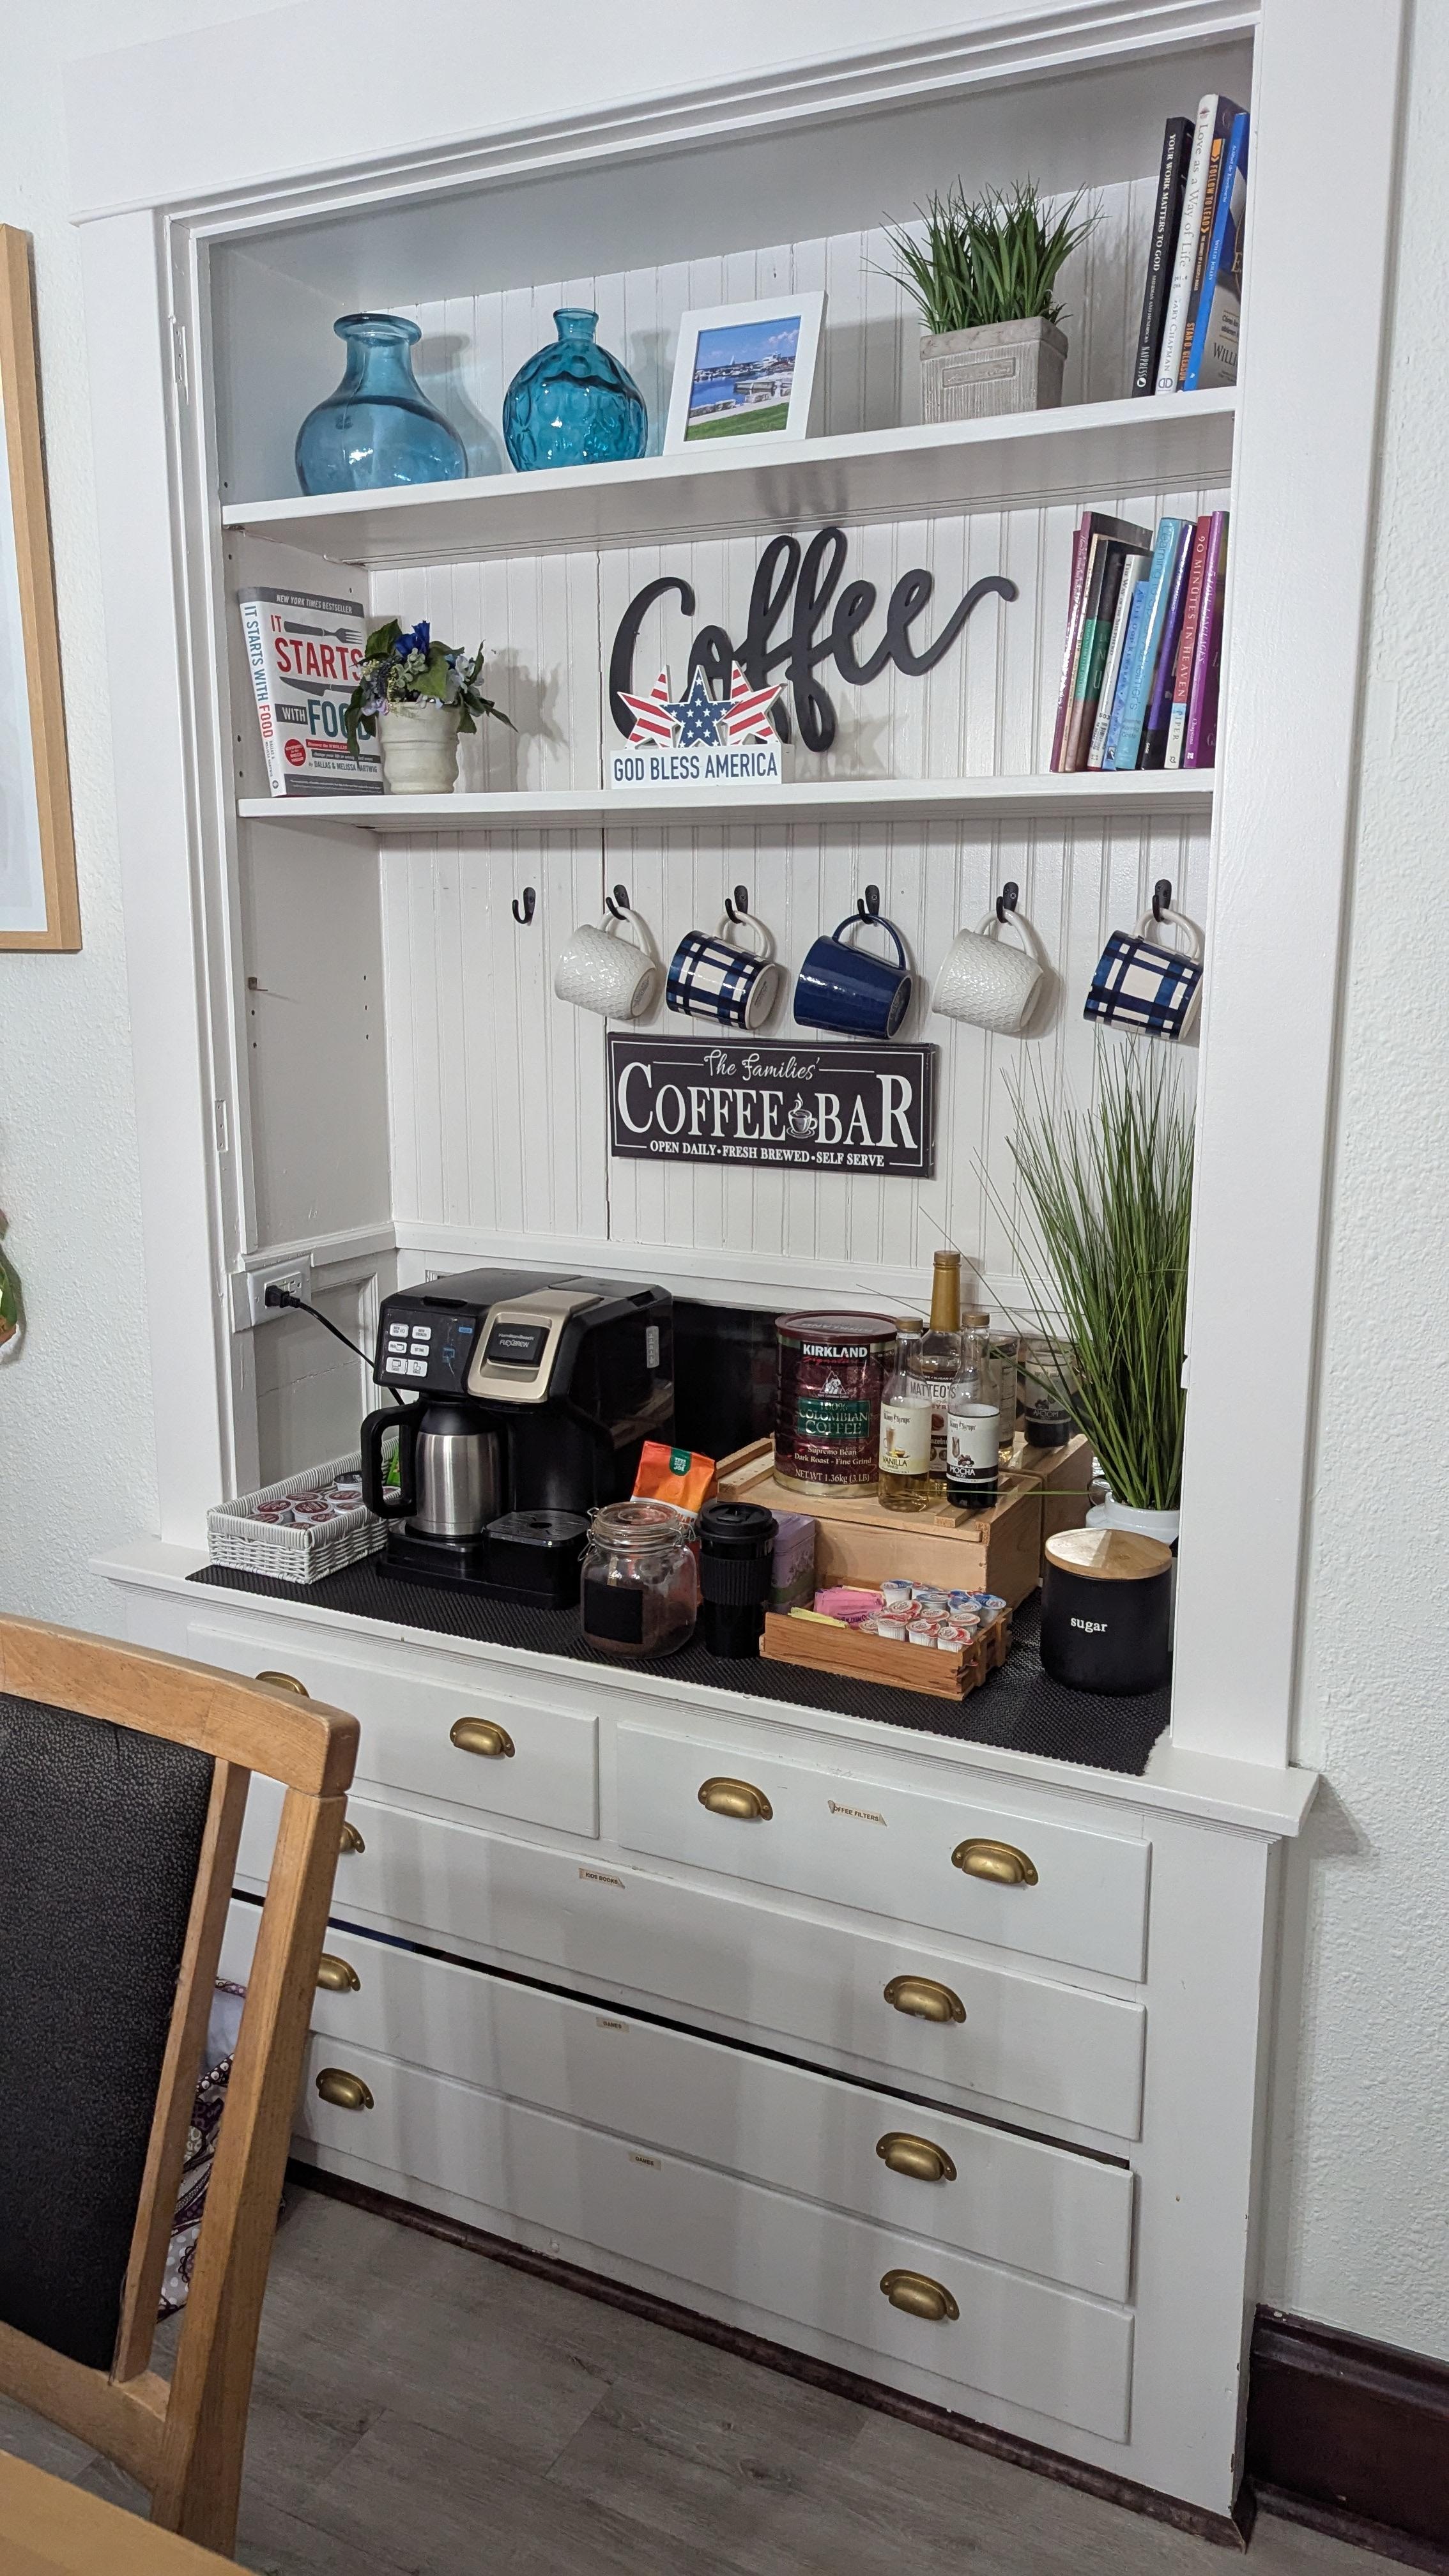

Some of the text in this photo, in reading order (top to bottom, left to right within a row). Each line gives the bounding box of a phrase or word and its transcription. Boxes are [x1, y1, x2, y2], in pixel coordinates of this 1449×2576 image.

[1167, 133, 1175, 160] YOUR
[1195, 123, 1208, 155] Love
[1163, 162, 1171, 190] WORK
[1193, 160, 1200, 172] as
[1184, 188, 1199, 217] Way
[1201, 164, 1218, 226] FOLLOW TO LEAD
[1158, 192, 1168, 233] MATTERS
[1156, 234, 1163, 247] TO
[1183, 222, 1195, 237] of
[1179, 241, 1192, 267] Life
[1184, 322, 1195, 341] STAN
[1163, 323, 1176, 371] CHAPMAN
[1213, 342, 1237, 367] WILLI
[1138, 345, 1150, 378] NAVPRESS
[1178, 349, 1190, 381] GLEASON
[1152, 524, 1171, 579] Learning
[1123, 561, 1131, 576] THE
[276, 594, 353, 614] NEW YORK TIMES BESTSELLER
[270, 615, 282, 632] IT
[1177, 535, 1205, 698] 90 MINUTES IN HEAVEN
[609, 526, 1018, 753] Coffee
[1109, 618, 1121, 656] SHEPHERD
[275, 637, 363, 682] STARTS
[244, 605, 274, 738] IT STARTS WITH FOOD
[282, 707, 306, 722] WITH
[1172, 710, 1182, 741] PIPER
[613, 752, 778, 782] GOD BLESS AMERICA
[703, 1049, 820, 1081] The Families'
[618, 1061, 918, 1149] COFFEE BAR
[650, 1140, 884, 1167] OPEN DAILY FRESH BREWED SELF SERVE
[803, 1344, 868, 1358] KIRKLAND
[910, 1381, 956, 1399] MATTEO'S
[799, 1409, 868, 1422] COLOMBIAN
[820, 1402, 848, 1411] 100%
[806, 1420, 861, 1434] COFFEE
[808, 1446, 838, 1456] Supremo
[883, 1457, 907, 1467] VANILLA
[795, 1469, 808, 1478] NET
[809, 1471, 822, 1481] WT
[825, 1474, 847, 1484] 1.36kg
[950, 1466, 976, 1476] MOCHA
[1071, 1617, 1108, 1633] sugar
[834, 1806, 879, 1821] OFFEE FILTERS
[599, 1876, 618, 1884] BOOKS
[603, 2021, 622, 2029] GAMES
[635, 2156, 654, 2166] GAMES
